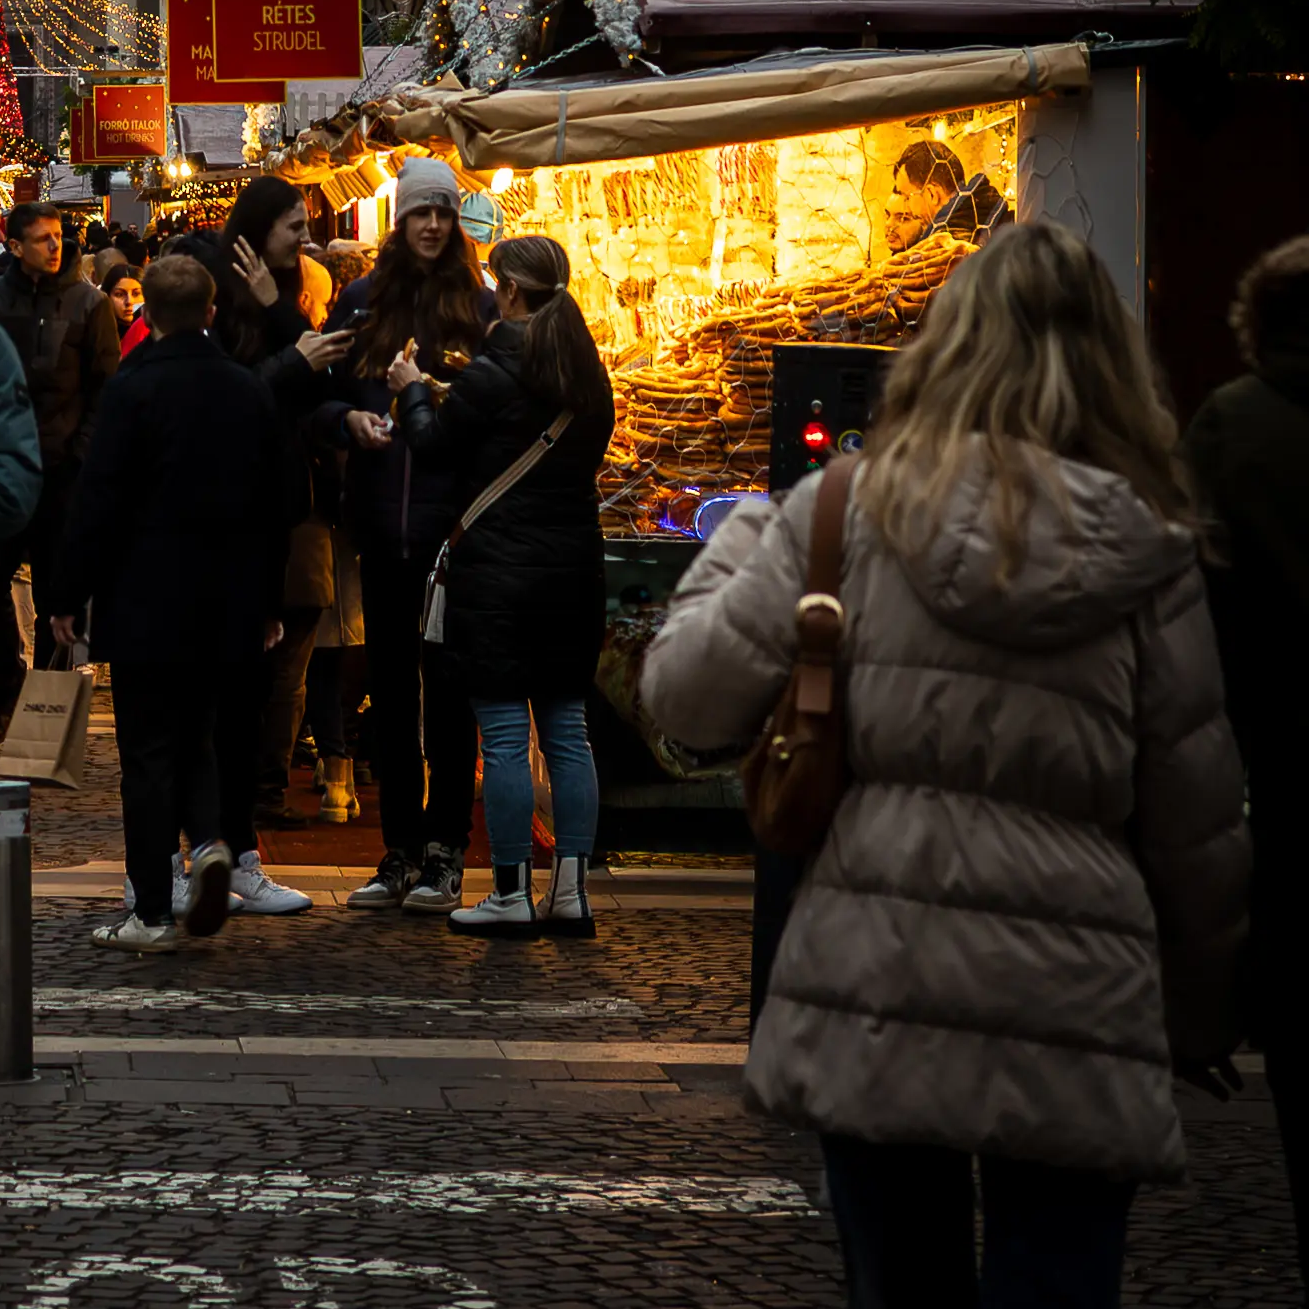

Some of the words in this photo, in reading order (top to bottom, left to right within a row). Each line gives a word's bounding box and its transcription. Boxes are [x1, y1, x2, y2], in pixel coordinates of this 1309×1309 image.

[262, 0, 316, 25] RÉTES
[253, 31, 326, 51] STRUDEL
[99, 118, 129, 131] FORRÓ
[131, 119, 161, 130] ITALOK
[106, 133, 123, 143] HOT
[125, 132, 155, 143] DRINKS
